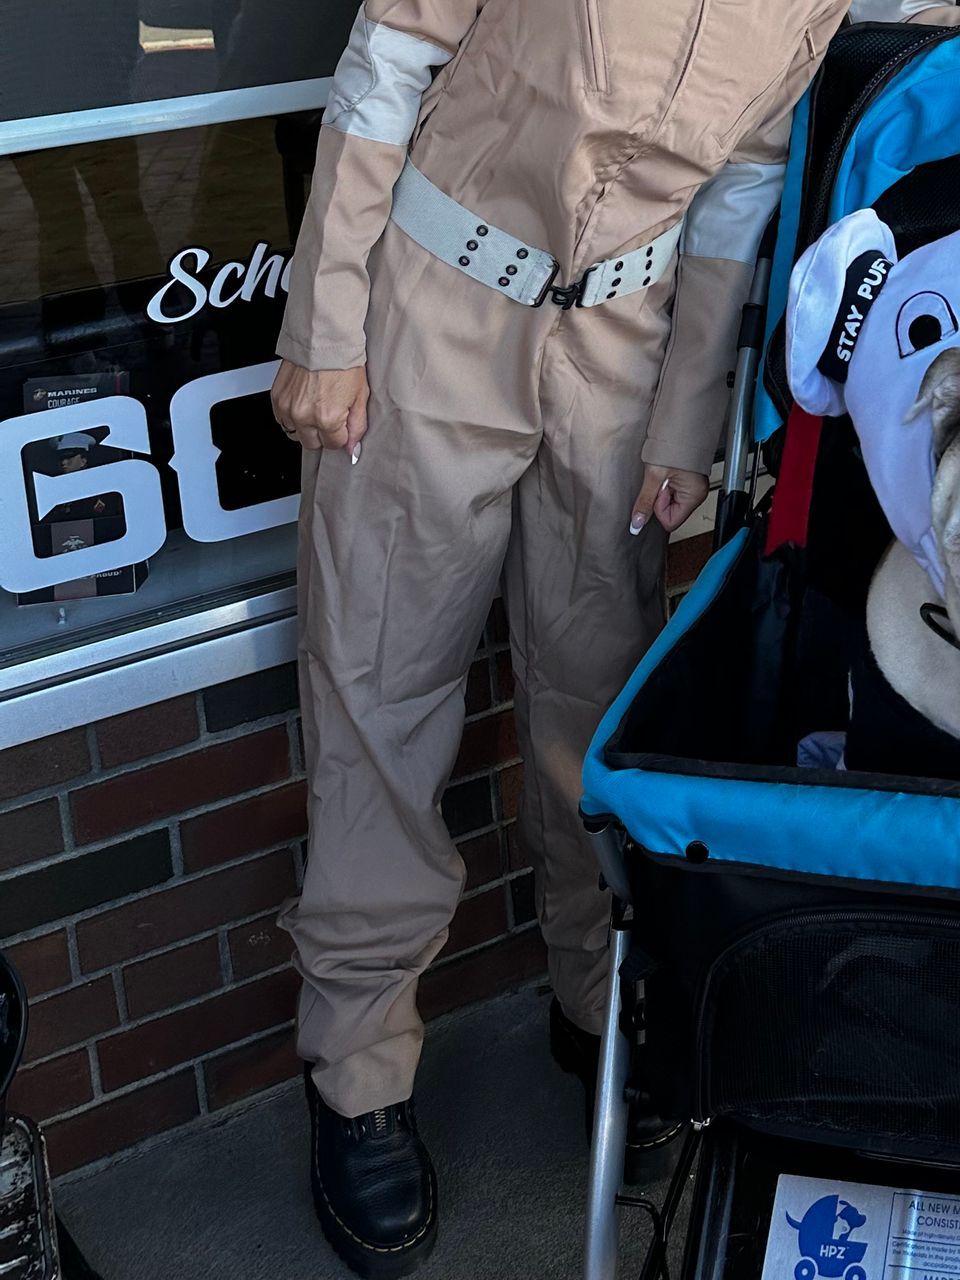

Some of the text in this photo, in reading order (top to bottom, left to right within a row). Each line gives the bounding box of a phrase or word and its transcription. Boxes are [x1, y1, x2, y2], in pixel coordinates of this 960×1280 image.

[836, 304, 864, 362] STAY
[47, 387, 98, 398] MARINES
[908, 1200, 925, 1213] ALL
[928, 1202, 951, 1216] NEW
[819, 1244, 847, 1260] HPZ
